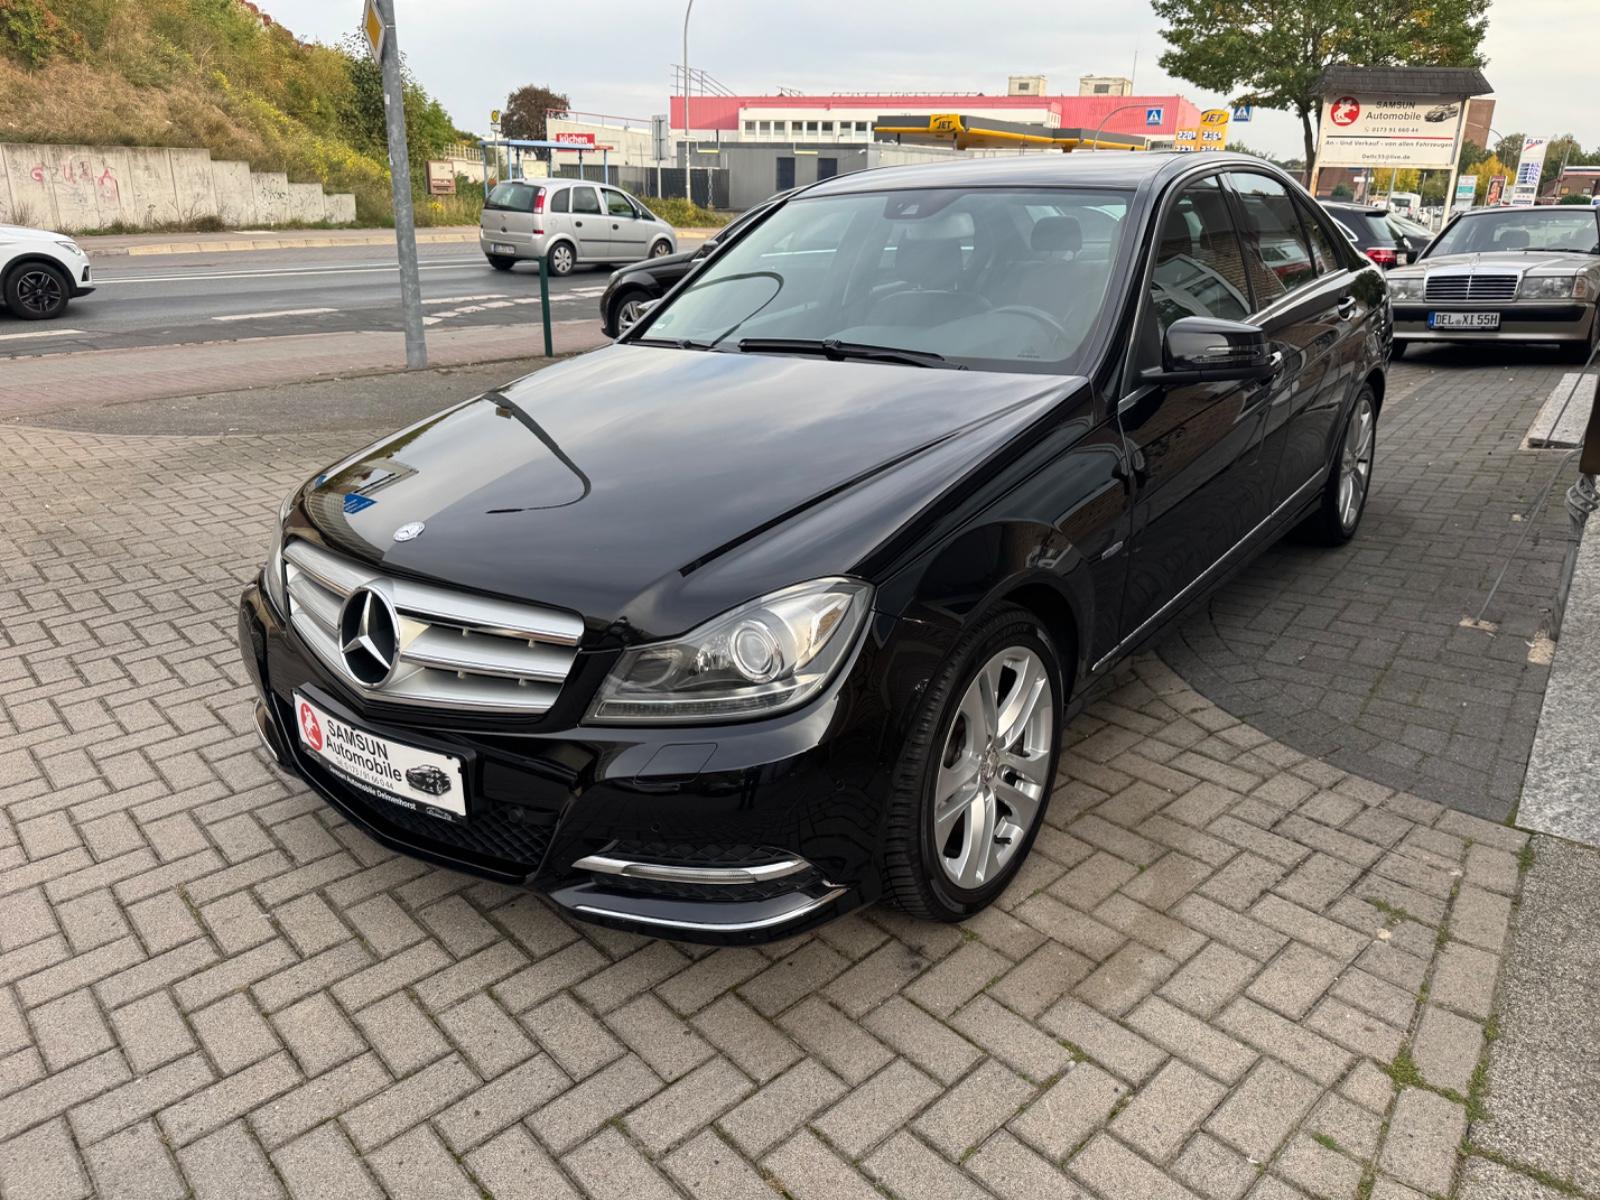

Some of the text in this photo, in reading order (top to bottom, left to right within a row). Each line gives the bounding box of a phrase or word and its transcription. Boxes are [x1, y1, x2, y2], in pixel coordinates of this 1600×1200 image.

[1375, 101, 1416, 109] SAMSUN
[1202, 114, 1224, 122] JET
[1365, 111, 1422, 121] Automobile
[938, 120, 953, 129] JET
[1436, 314, 1498, 325] DEL XI 55H
[326, 719, 389, 761] SAMSUN
[326, 734, 402, 782] Automobile
